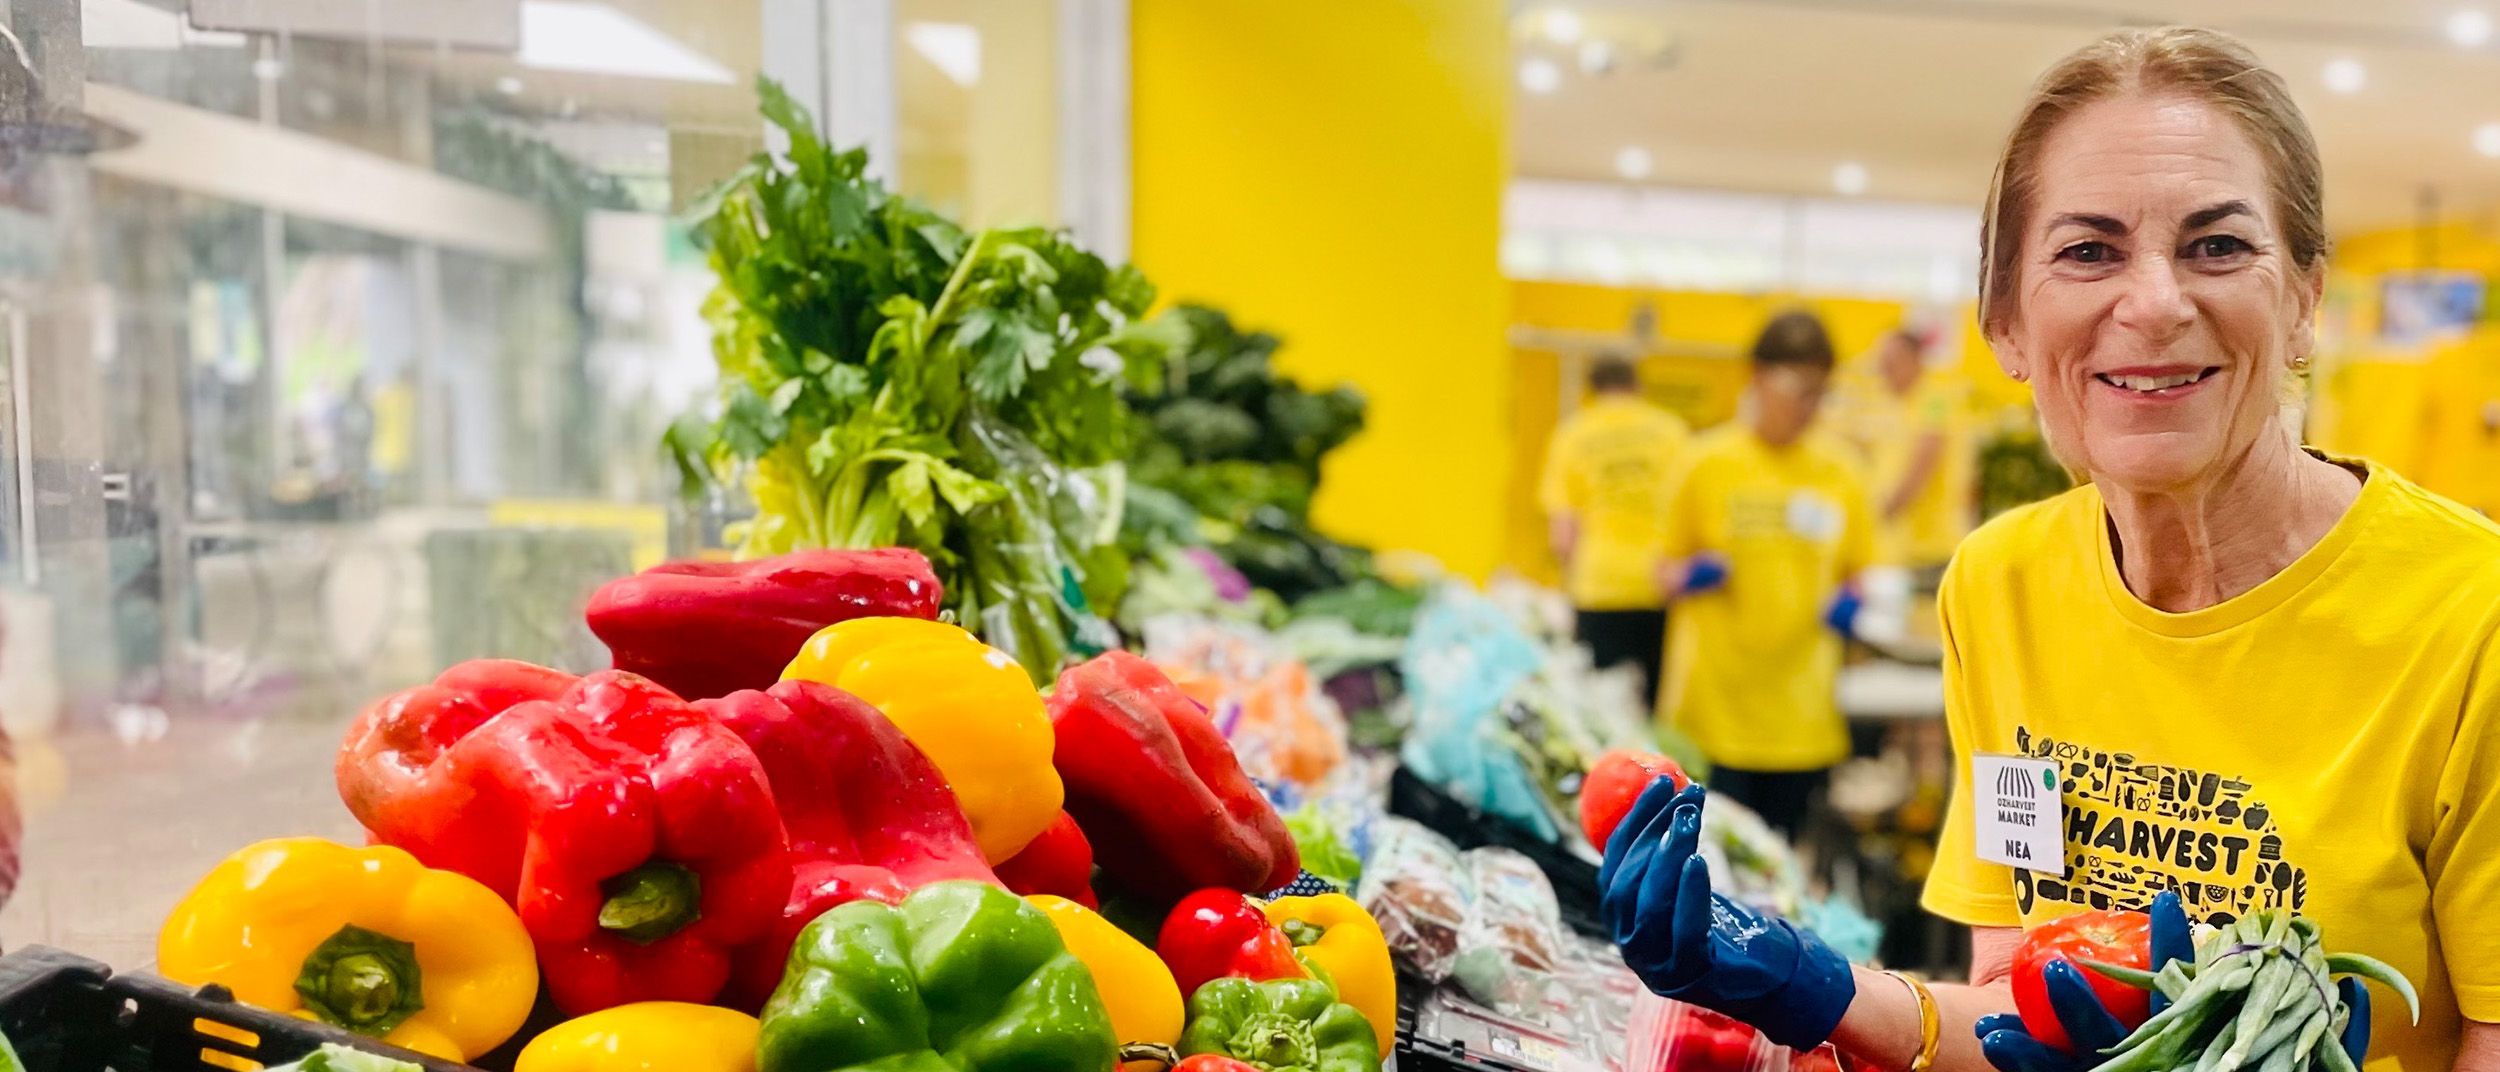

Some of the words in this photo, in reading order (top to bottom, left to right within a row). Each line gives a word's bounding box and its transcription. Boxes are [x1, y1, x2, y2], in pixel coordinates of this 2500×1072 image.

[1997, 798, 2036, 811] OZHARVEST
[1998, 809, 2036, 827] MARKET
[2062, 803, 2249, 876] HARVEST
[2005, 839, 2031, 860] NEA
